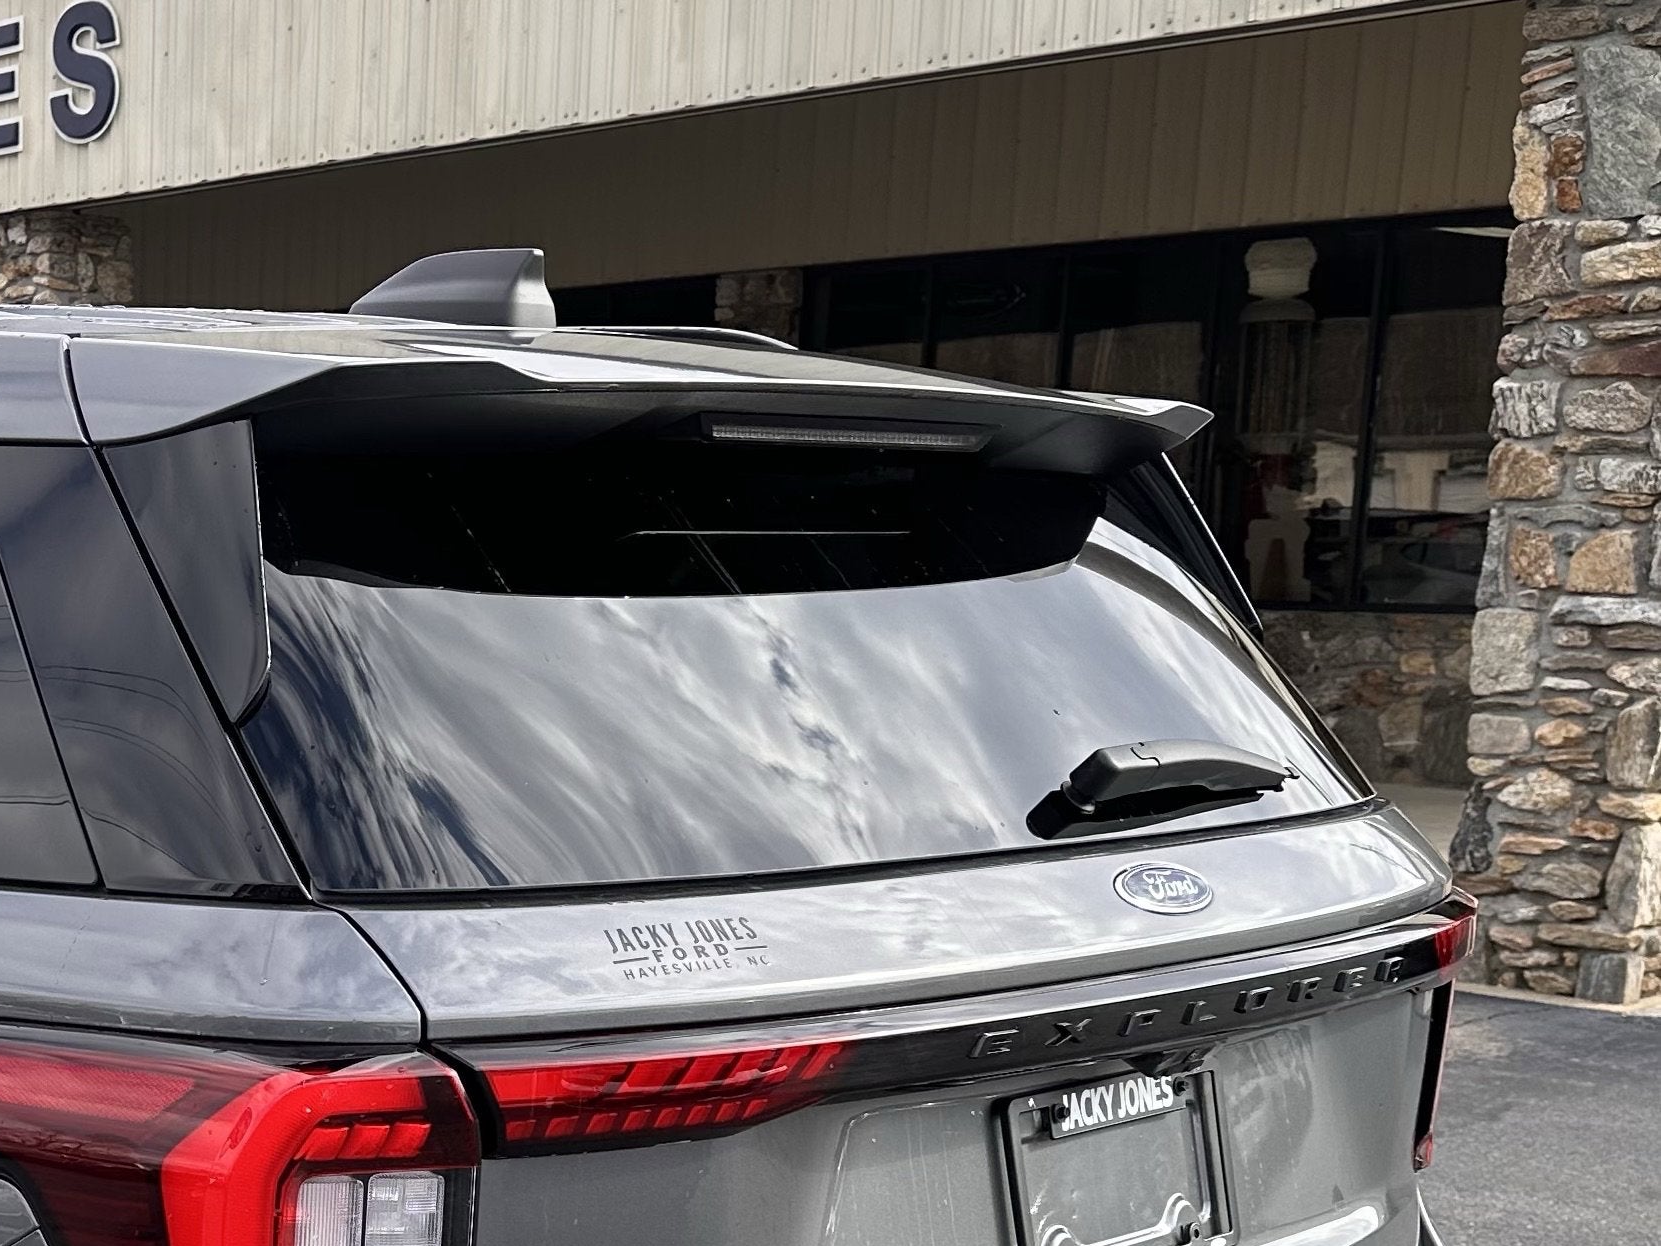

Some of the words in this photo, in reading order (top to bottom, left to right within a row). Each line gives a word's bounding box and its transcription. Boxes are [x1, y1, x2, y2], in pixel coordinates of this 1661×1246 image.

[1142, 869, 1199, 900] Ford
[603, 922, 680, 954] JACKY
[684, 916, 758, 945] JONES
[651, 943, 729, 963] FORD
[746, 954, 771, 967] NC
[967, 955, 1406, 1059] EXPLORER
[1117, 1075, 1174, 1119] JONES
